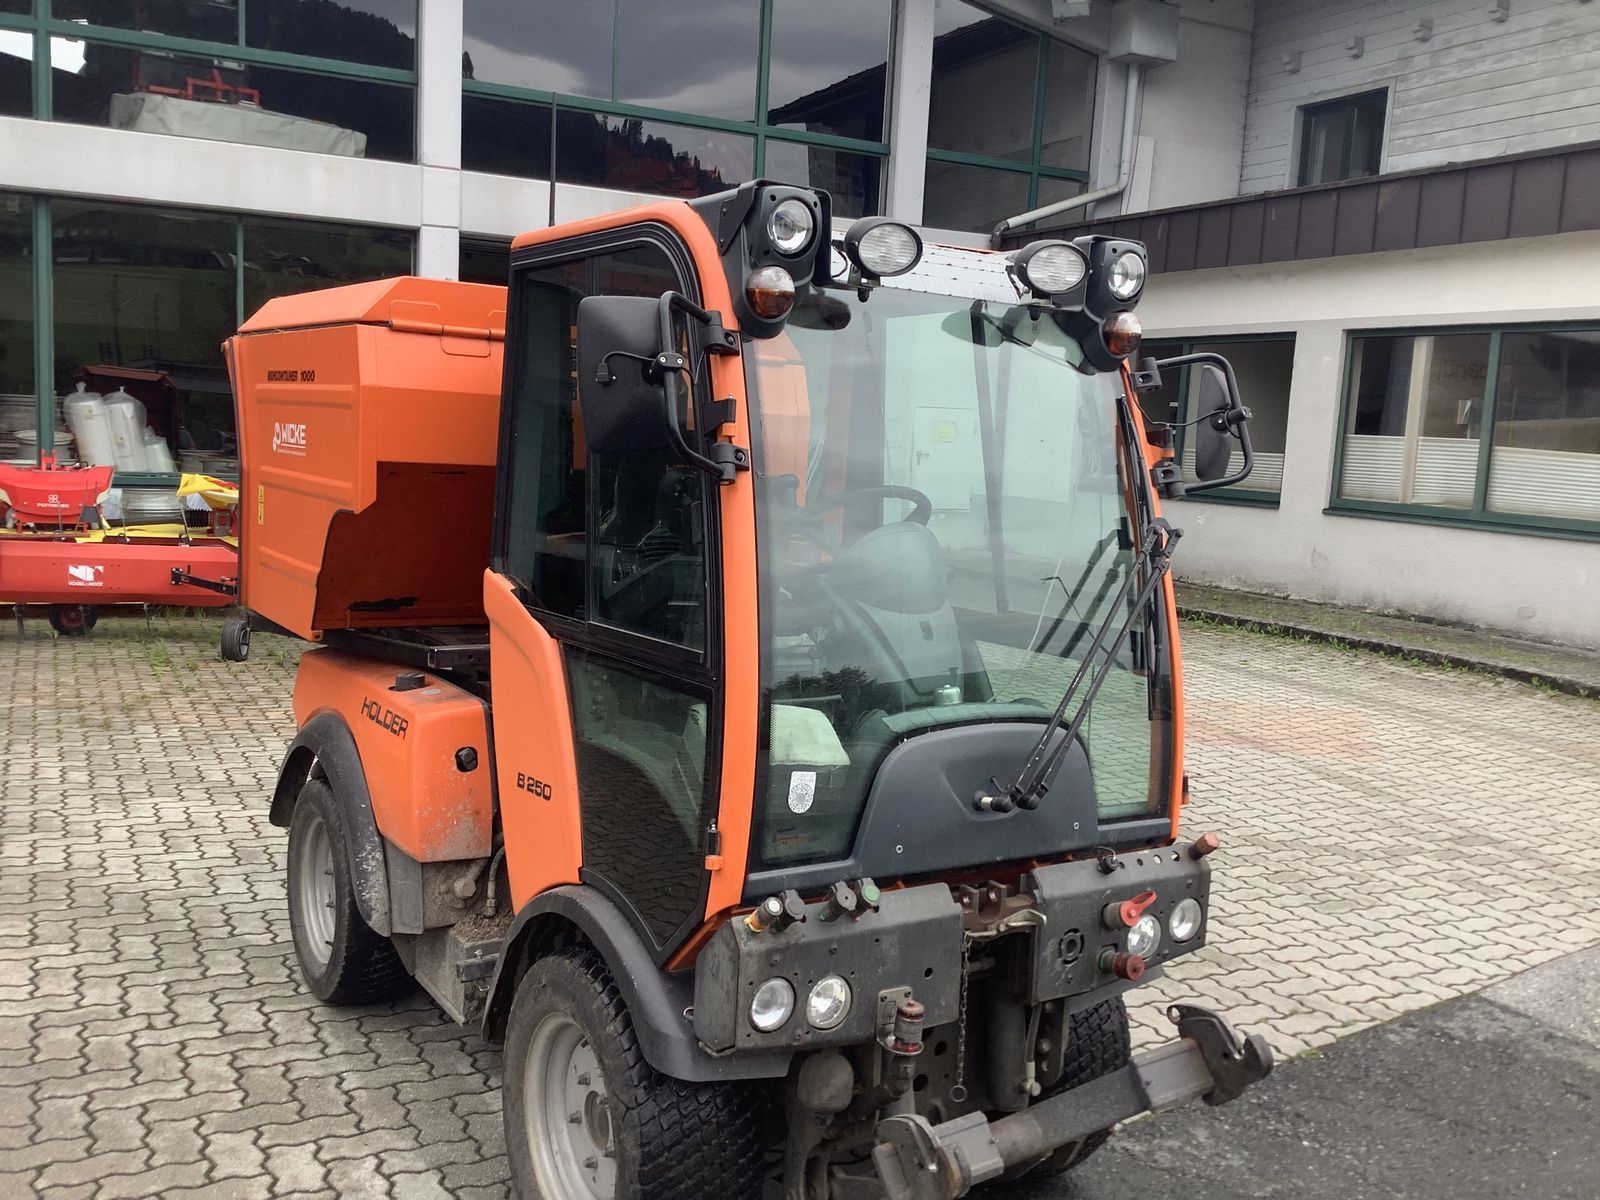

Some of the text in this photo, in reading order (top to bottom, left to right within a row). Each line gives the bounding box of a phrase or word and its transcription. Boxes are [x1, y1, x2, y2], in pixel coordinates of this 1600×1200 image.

[300, 370, 316, 382] 1000
[281, 423, 307, 445] WICKE
[361, 697, 409, 740] HOLDER
[517, 772, 552, 801] B 250
